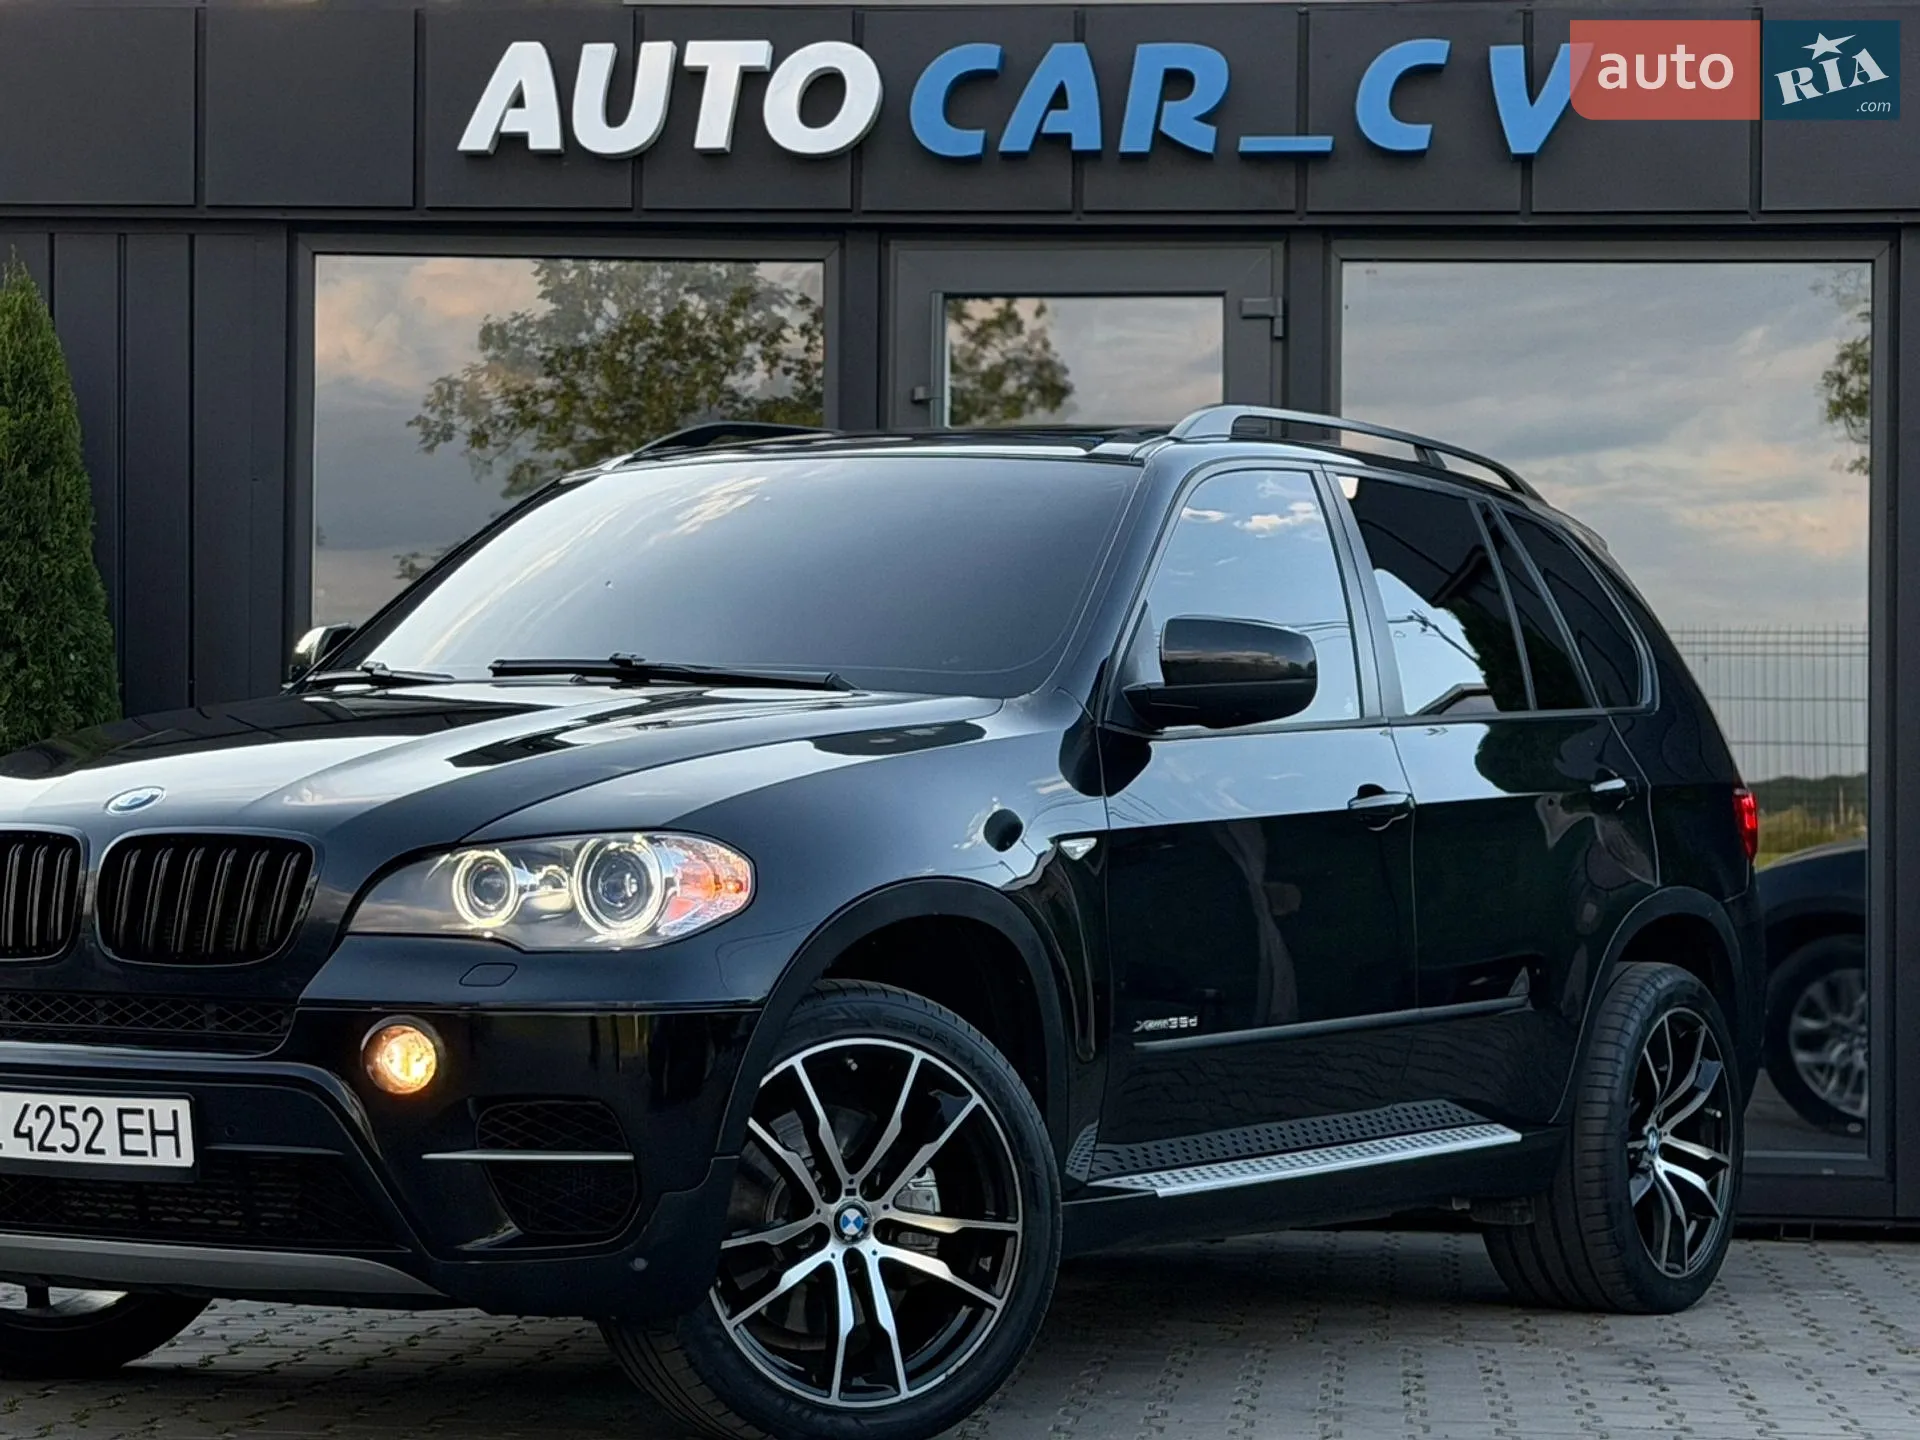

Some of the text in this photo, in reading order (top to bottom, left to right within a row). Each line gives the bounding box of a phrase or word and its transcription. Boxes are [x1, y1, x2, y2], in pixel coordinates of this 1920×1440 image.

[457, 41, 883, 158] AUTO
[13, 1103, 181, 1158] 4252 EH
